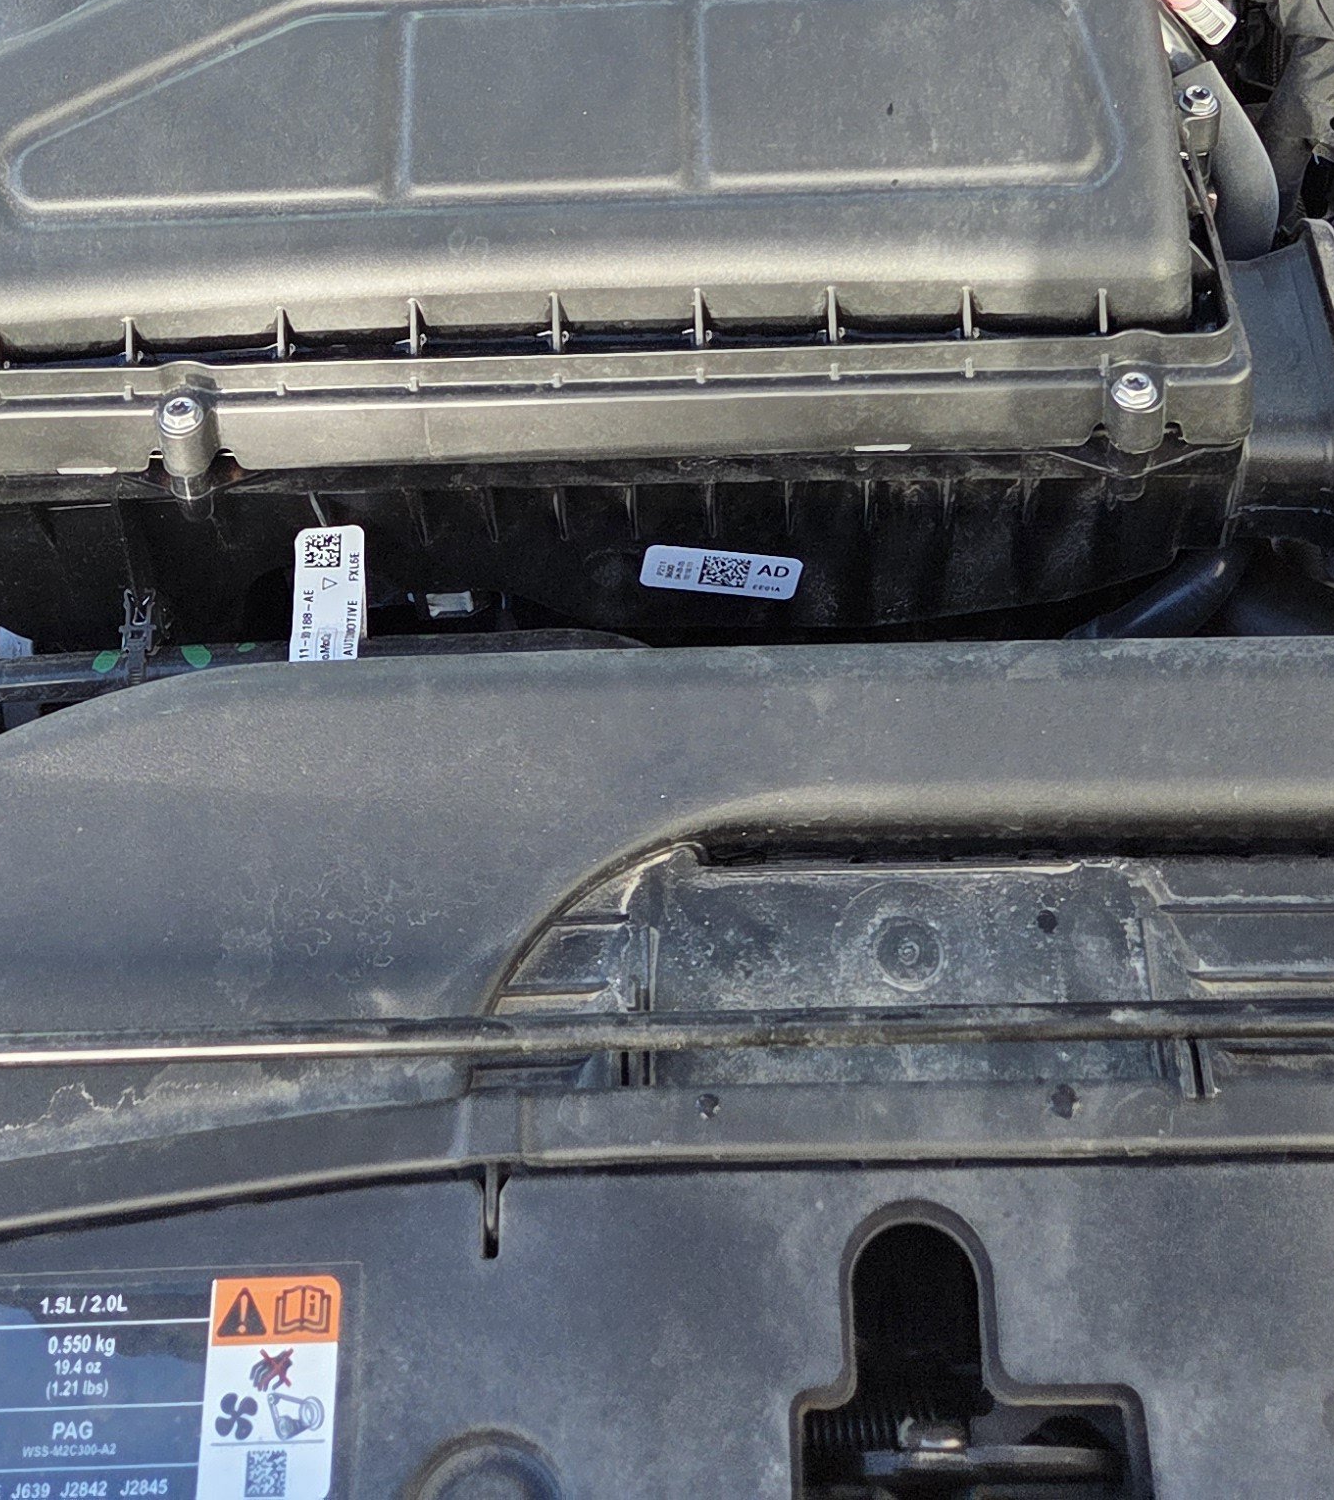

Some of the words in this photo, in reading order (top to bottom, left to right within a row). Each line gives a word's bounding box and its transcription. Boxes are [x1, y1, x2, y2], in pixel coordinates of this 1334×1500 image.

[757, 564, 789, 577] AD
[40, 1297, 76, 1315] 1.5L
[90, 1294, 128, 1313] 2.0L
[48, 1335, 91, 1354] 0.550
[95, 1334, 116, 1357] kg
[54, 1360, 82, 1376] 19.4
[86, 1361, 101, 1374] oz
[46, 1380, 78, 1403] (1.21
[82, 1378, 109, 1397] lbs)
[52, 1420, 93, 1440] PAG
[11, 1482, 51, 1499] J639
[60, 1480, 108, 1498] J2842
[120, 1478, 168, 1497] J2845
